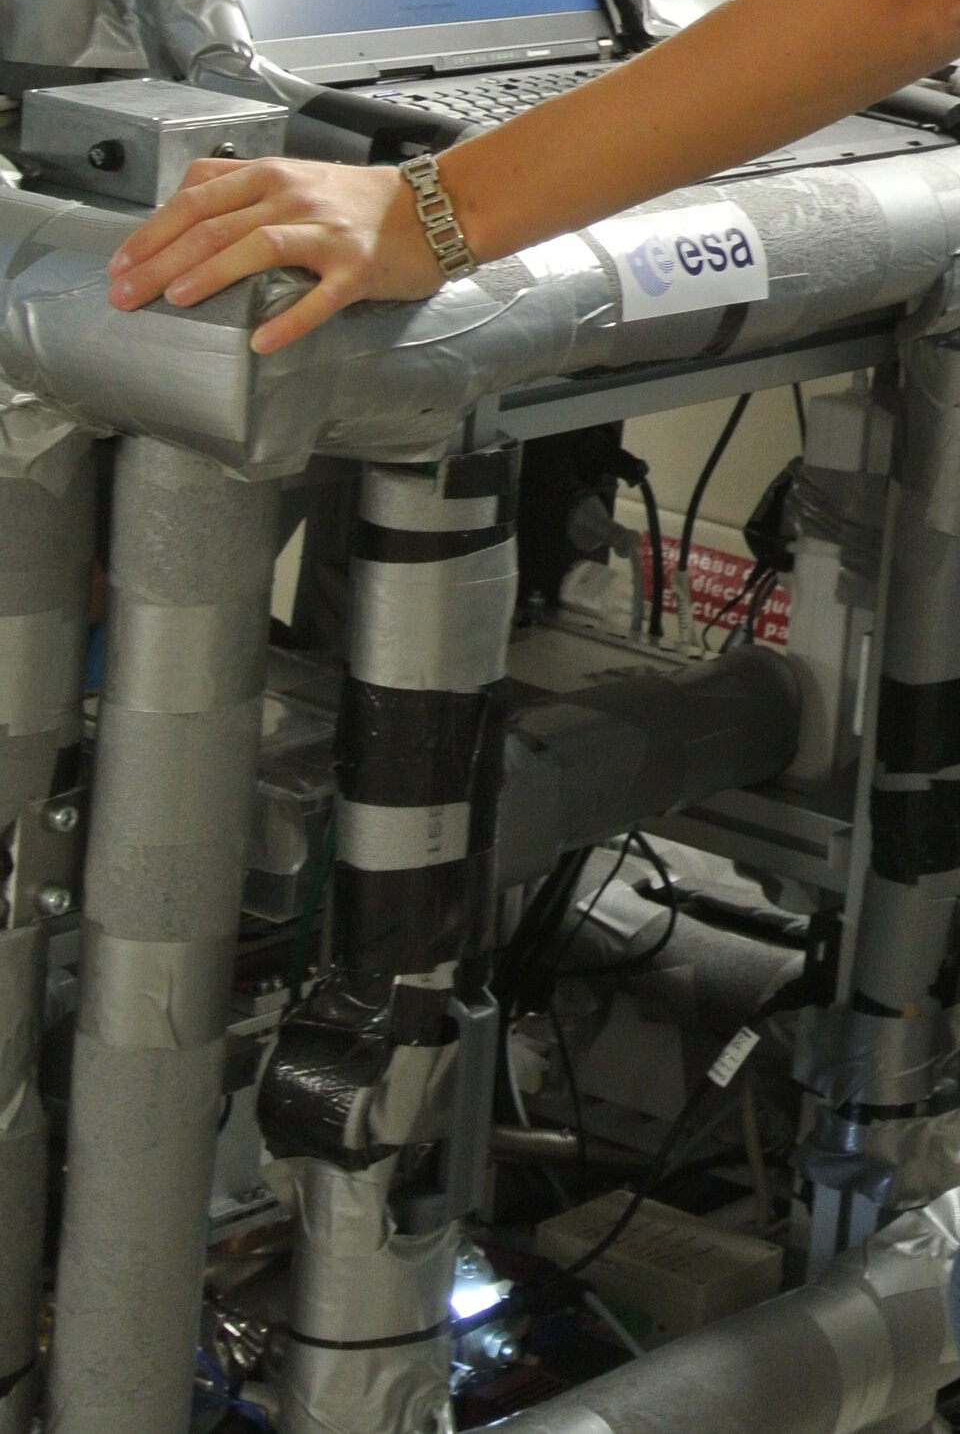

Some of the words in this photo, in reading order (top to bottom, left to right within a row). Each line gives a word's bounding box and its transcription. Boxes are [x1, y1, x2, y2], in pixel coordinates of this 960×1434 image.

[675, 228, 754, 276] esa
[648, 543, 737, 578] aneau
[661, 588, 758, 630] Elctrcal
[691, 574, 791, 617] élecrqu
